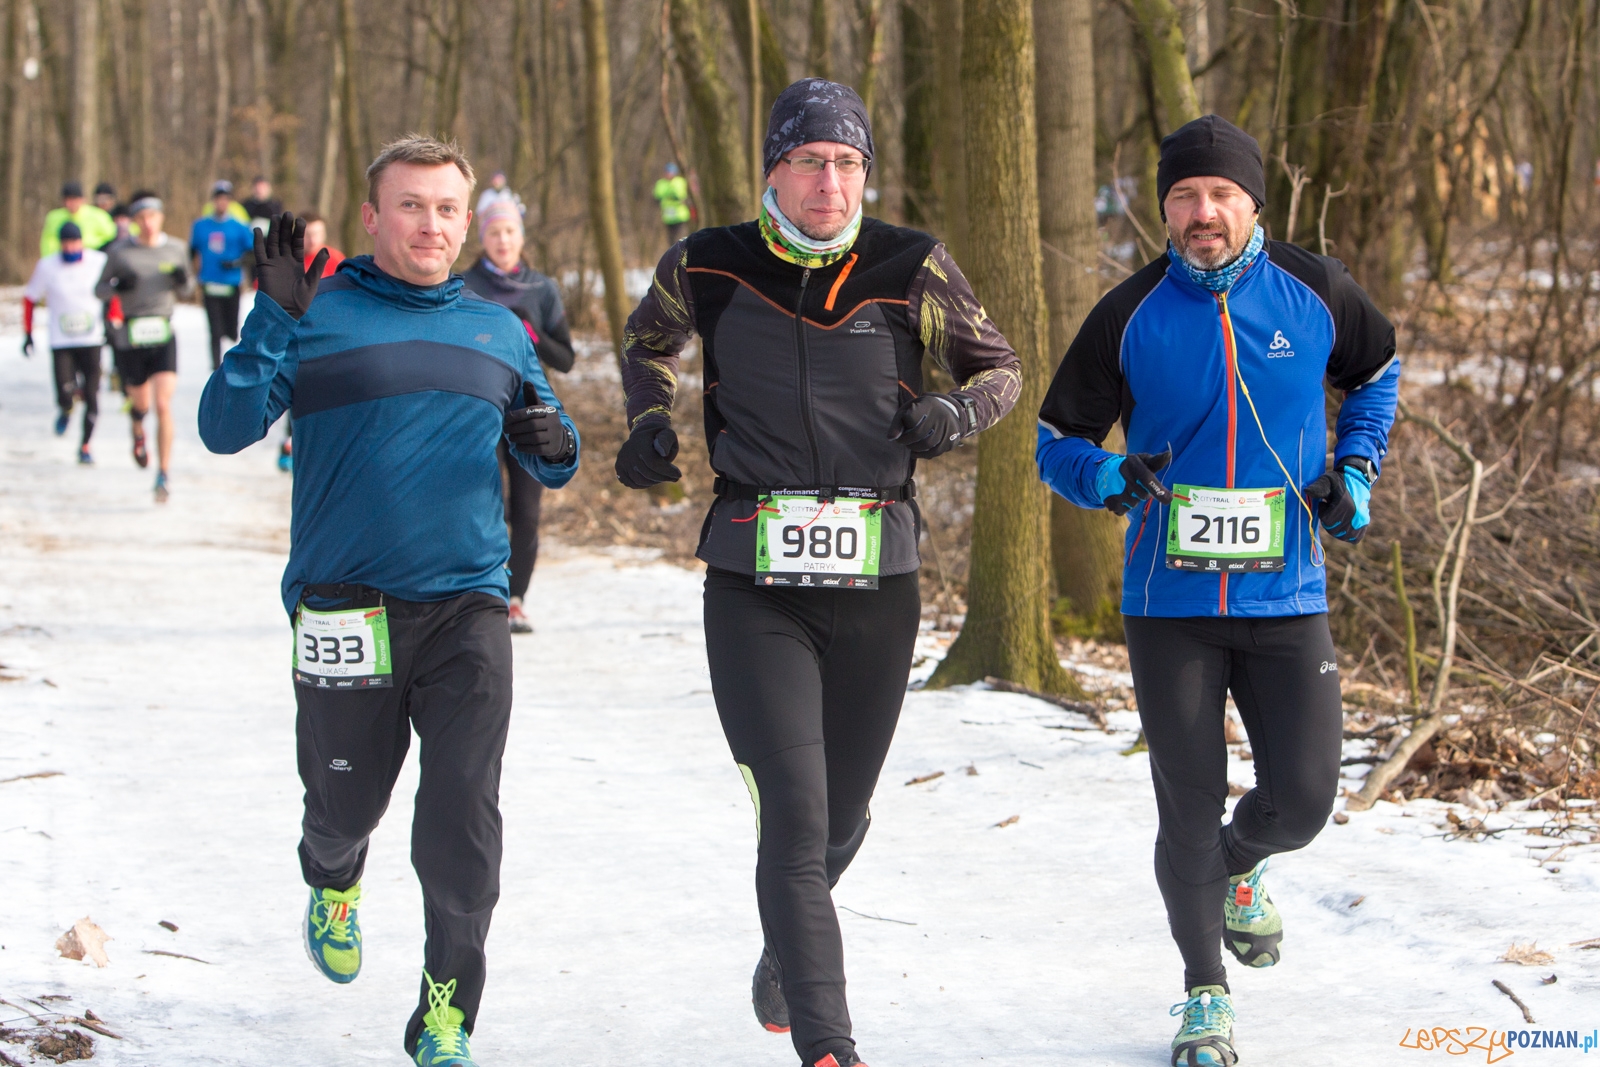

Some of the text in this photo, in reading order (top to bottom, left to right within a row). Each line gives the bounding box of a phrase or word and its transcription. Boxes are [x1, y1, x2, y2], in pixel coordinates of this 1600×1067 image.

[1267, 350, 1295, 359] odlo
[771, 488, 820, 496] performance
[782, 524, 858, 560] 980
[1190, 514, 1260, 545] 2116
[1273, 520, 1281, 548] Poznań
[868, 535, 877, 565] Poznań
[803, 562, 837, 571] PATRYK
[303, 633, 365, 665] 333
[379, 639, 387, 666] Poznań
[318, 667, 349, 675] ŁUKASZ
